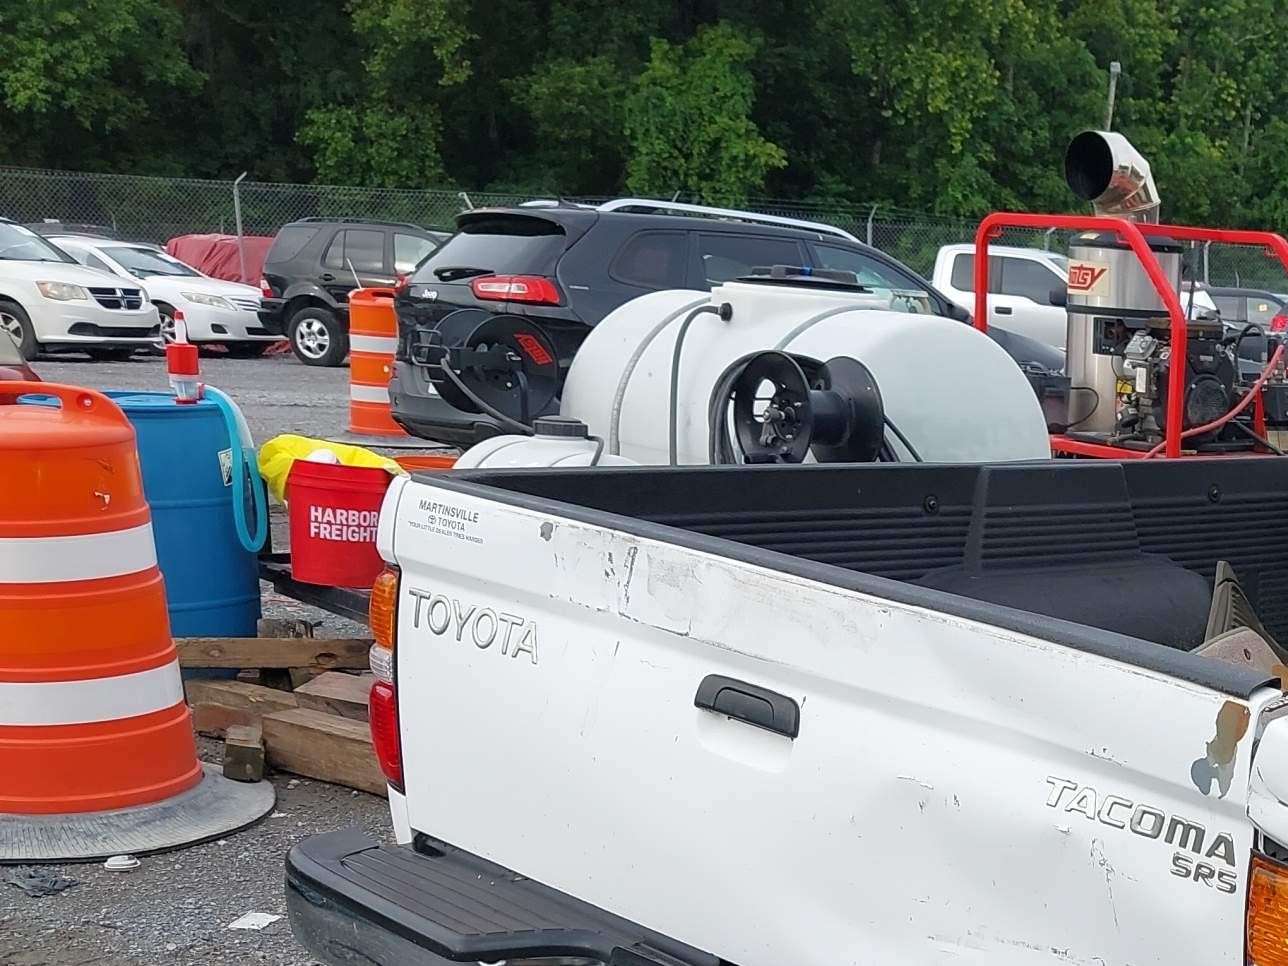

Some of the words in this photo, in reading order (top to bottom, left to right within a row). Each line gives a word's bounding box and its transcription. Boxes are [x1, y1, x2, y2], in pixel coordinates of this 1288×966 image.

[310, 505, 379, 527] HARBOR
[419, 499, 480, 523] MARTINSVILLE
[310, 522, 378, 543] FREIGHT
[438, 516, 466, 532] TOYOTA
[409, 587, 538, 665] TOYOTA
[1046, 776, 1236, 867] TACOMA
[1170, 851, 1237, 894] SR5
